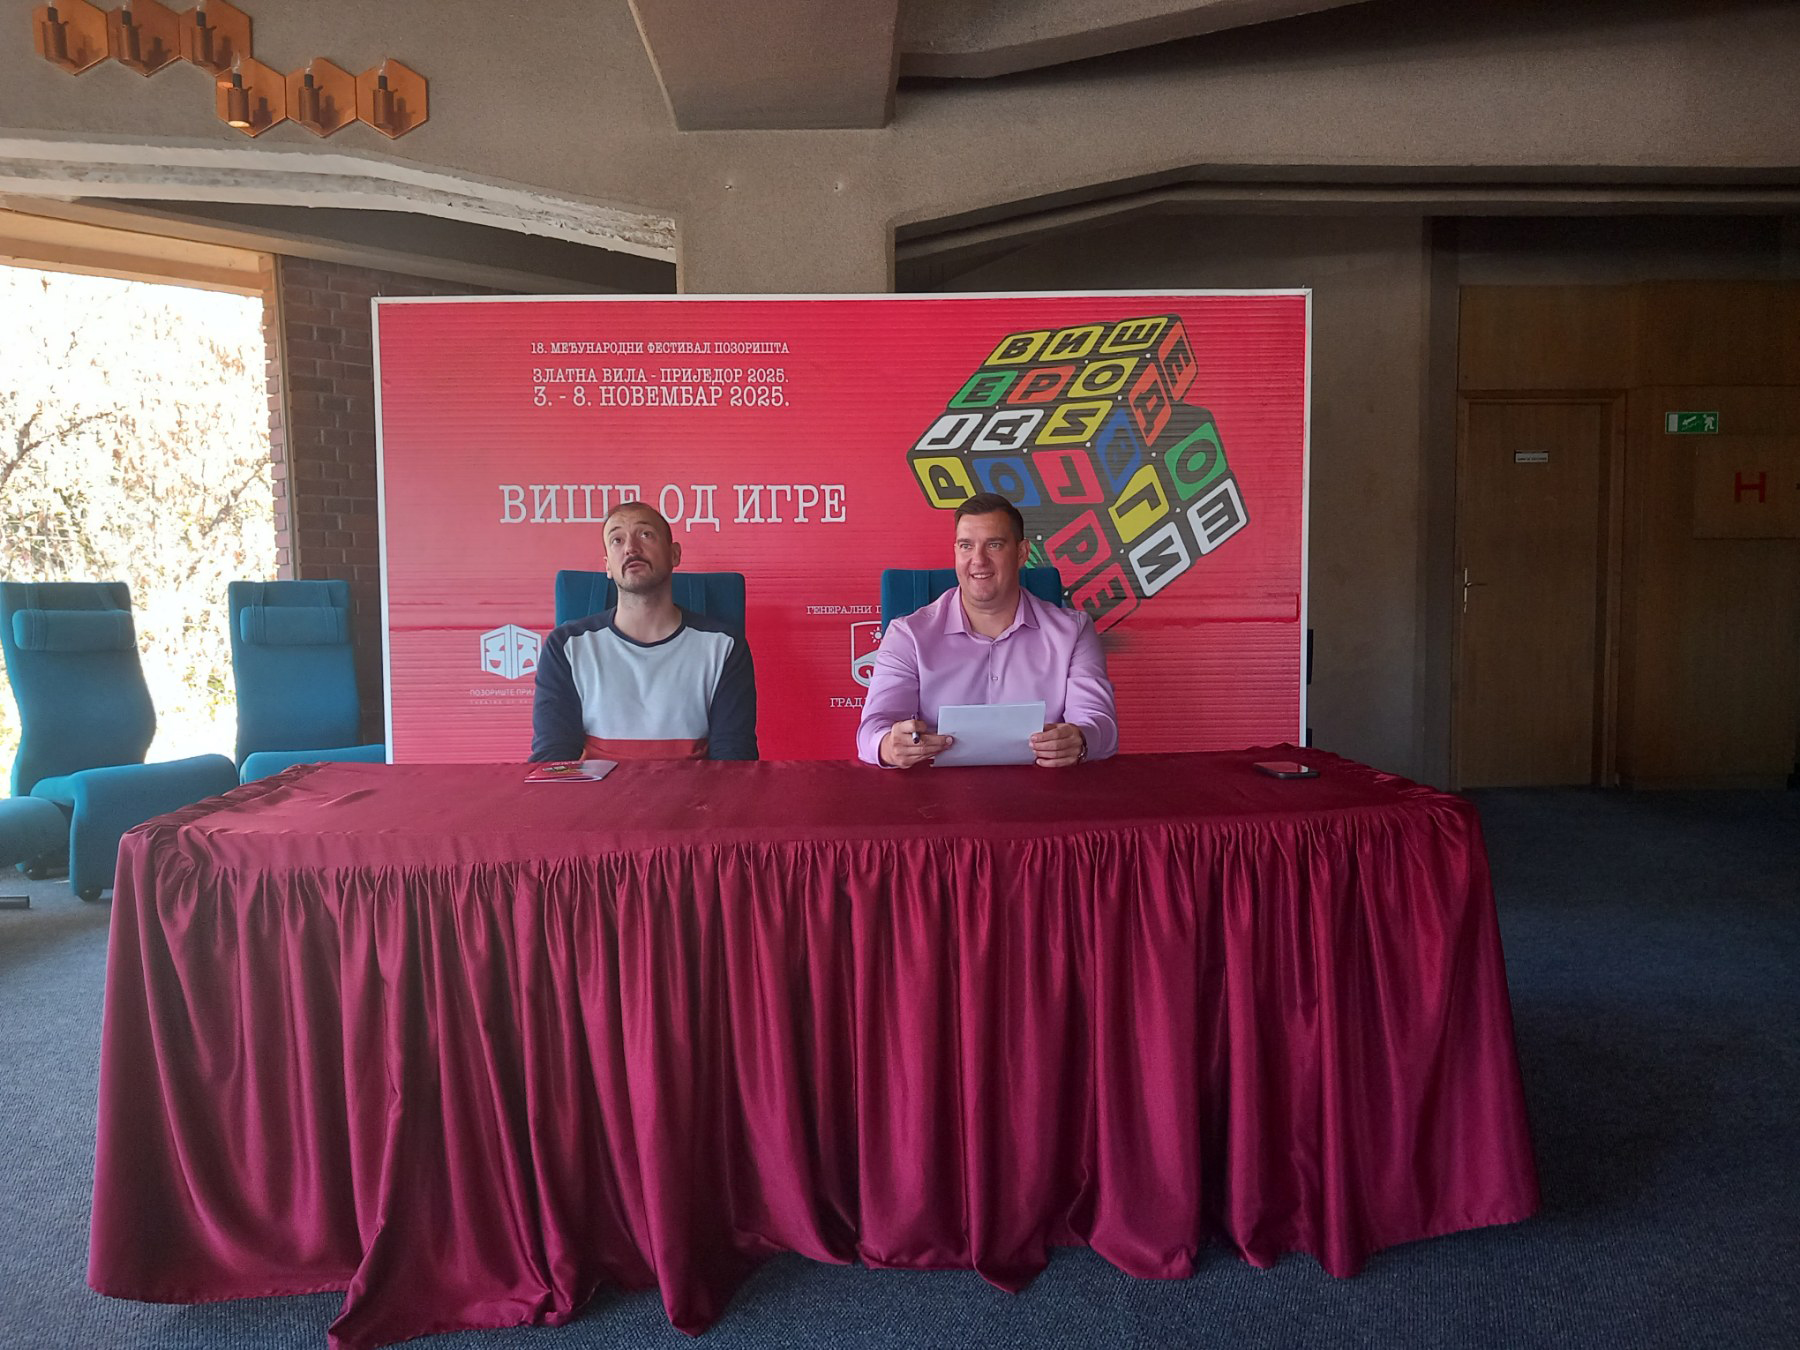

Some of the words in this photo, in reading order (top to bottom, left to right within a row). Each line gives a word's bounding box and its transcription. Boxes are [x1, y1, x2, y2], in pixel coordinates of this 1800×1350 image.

[531, 341, 548, 354] 18.
[550, 341, 644, 356] МЕЂУНАРОДНИ
[647, 341, 712, 354] ФЕСТИВАЛ
[714, 341, 790, 354] ПОЗОРИШТА
[533, 367, 599, 383] ЗЛАТНА
[602, 367, 648, 383] ВИЛА
[660, 367, 743, 386] ПРИЈЕДОР
[747, 367, 789, 383] 2025.
[533, 385, 553, 407] 3.
[573, 385, 592, 407] 8.
[599, 385, 723, 407] НОВЕМБАР
[730, 385, 790, 407] 2025.
[658, 483, 720, 533] ОД
[733, 484, 846, 524] ИГРЕ
[806, 605, 872, 615] ГЕНЕРАЛНИ
[469, 688, 515, 697] ПОЗОРИШТЕ
[829, 697, 863, 709] ГРАД
